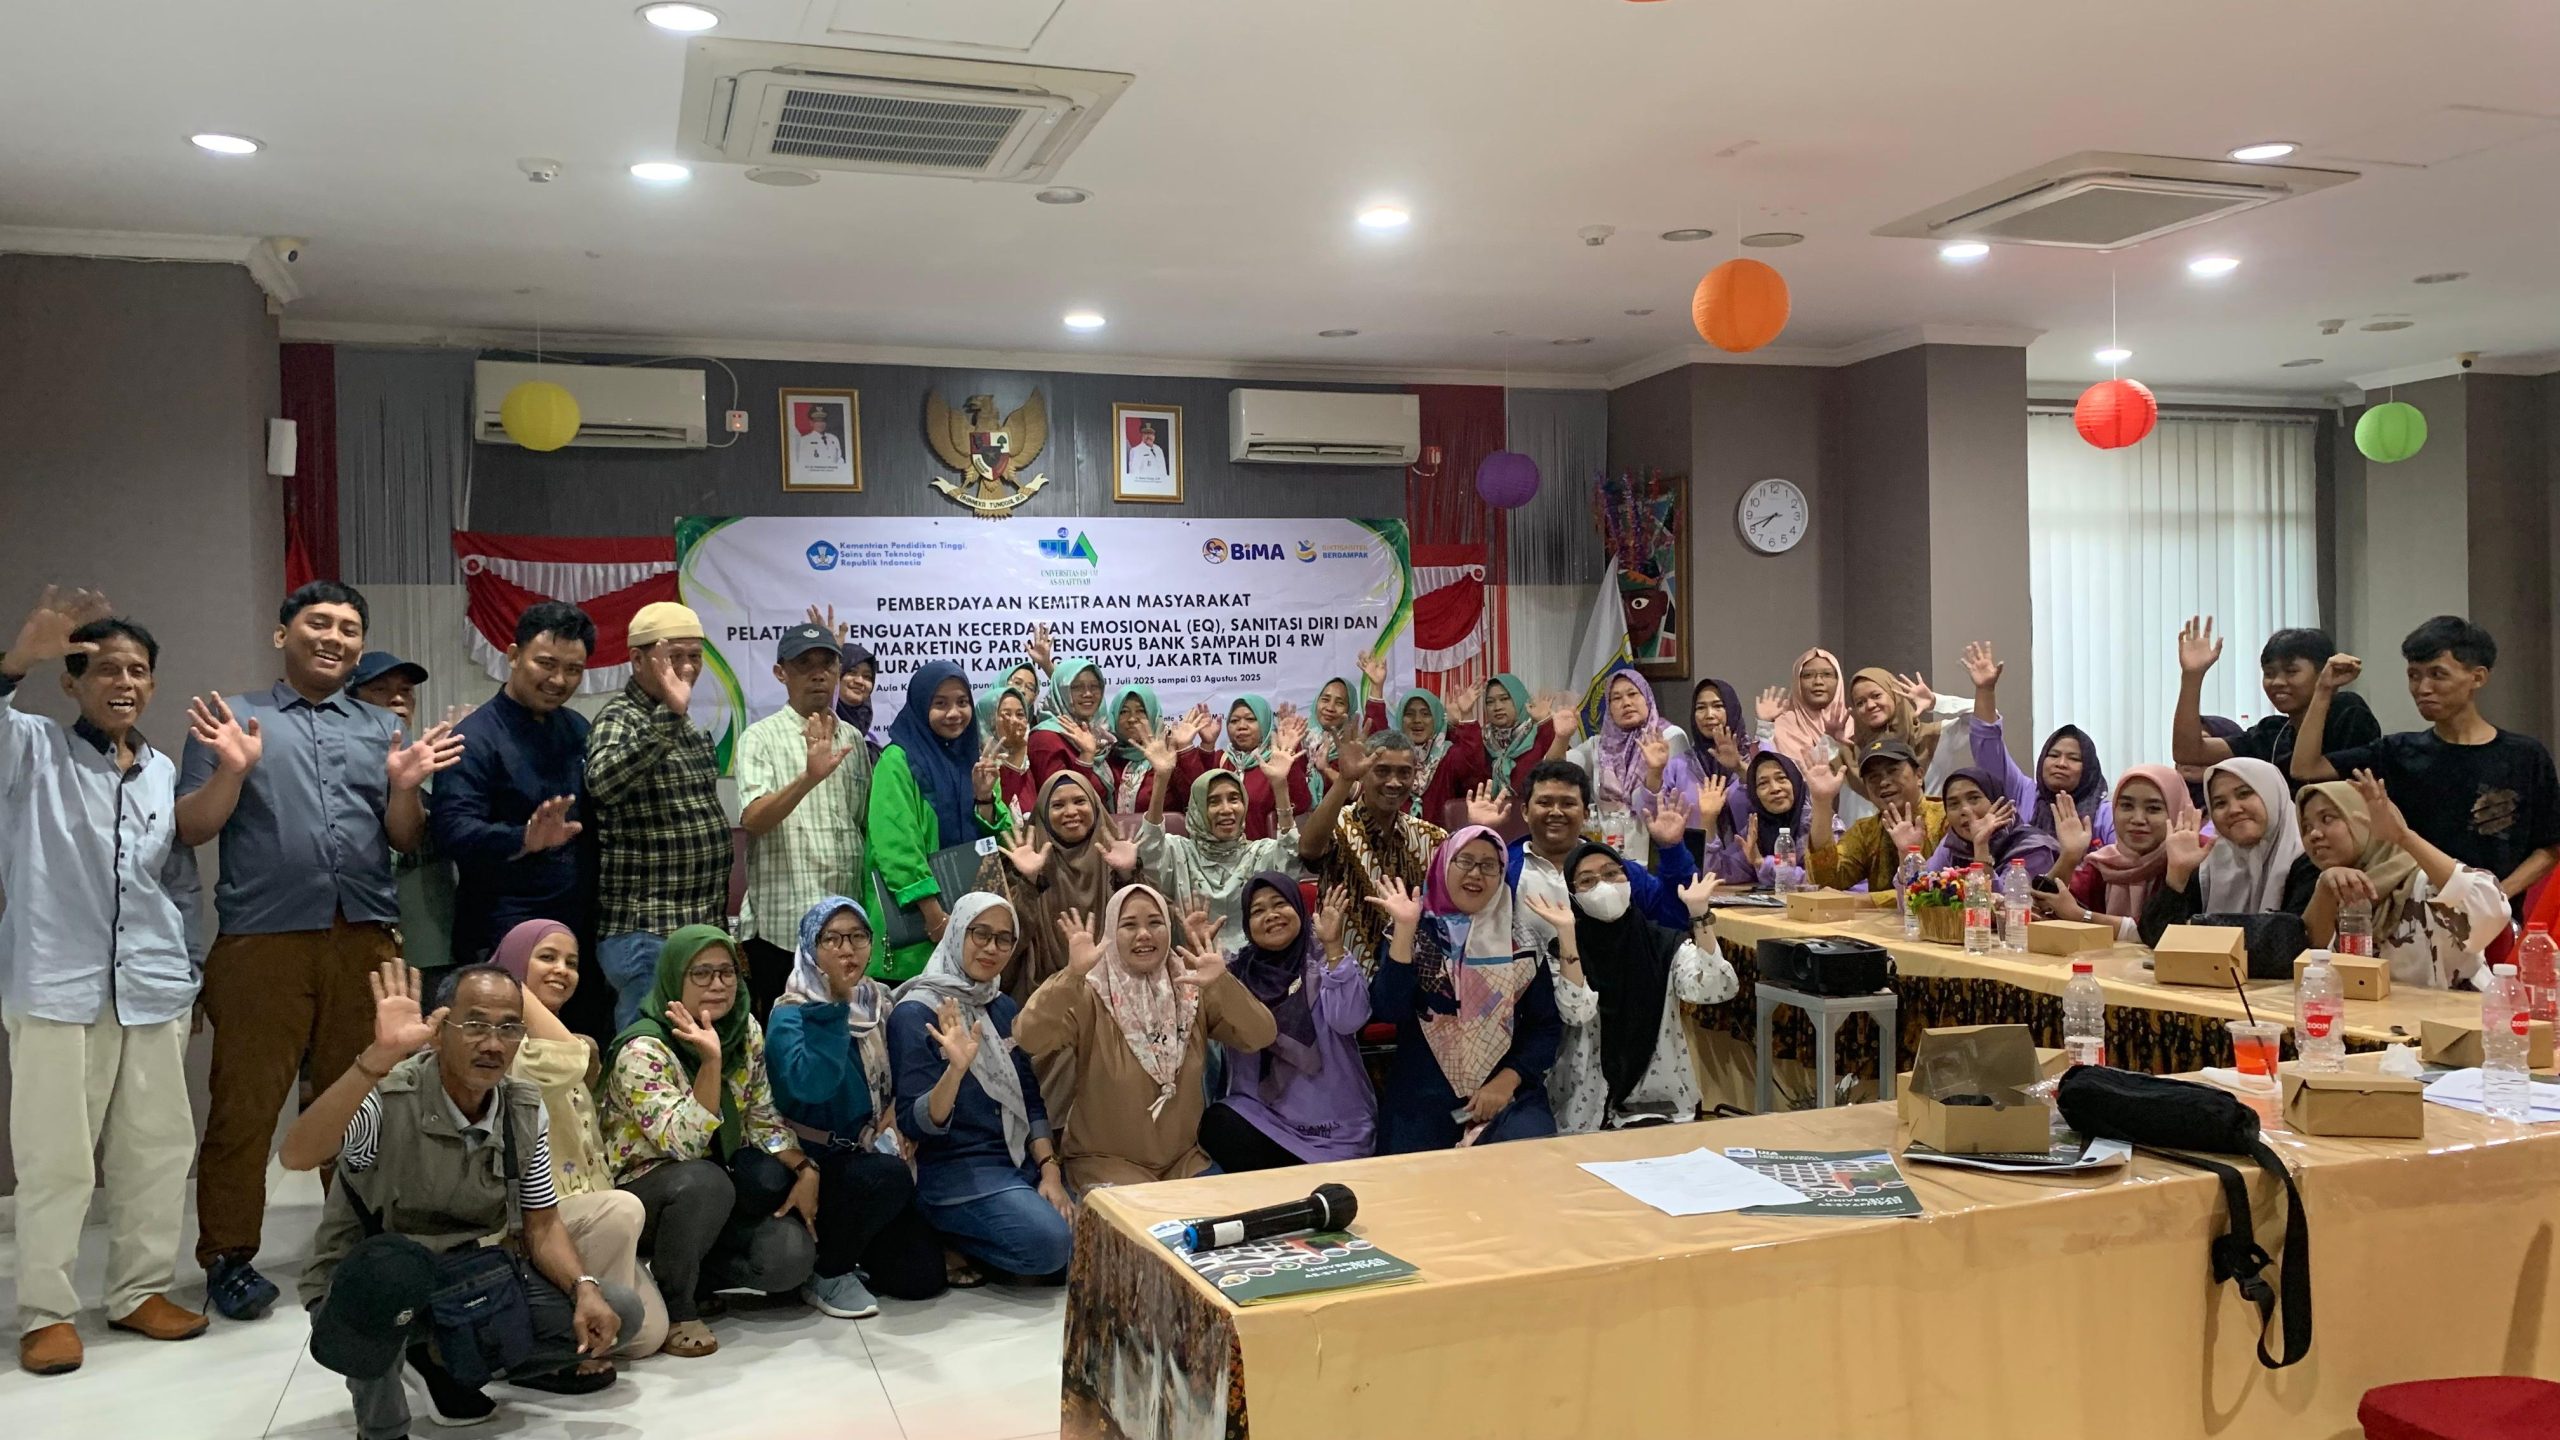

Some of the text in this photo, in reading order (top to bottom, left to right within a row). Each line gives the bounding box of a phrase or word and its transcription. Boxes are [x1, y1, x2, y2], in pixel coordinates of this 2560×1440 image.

[1760, 488, 1766, 497] 11
[1770, 484, 1779, 494] 12
[1750, 498, 1760, 507] 10
[1791, 499, 1798, 509] 2
[1746, 510, 1753, 520] 9
[1793, 511, 1800, 521] 3
[1789, 526, 1796, 535] 4
[1758, 534, 1764, 543] 7
[1768, 538, 1776, 547] 6
[1780, 534, 1787, 544] 5
[840, 542, 888, 550] Kementrian
[866, 550, 882, 558] dan
[884, 550, 925, 559] Teknologi
[841, 559, 878, 567] Republik
[877, 594, 1251, 611] PEMBERDAYAAN KEMITRAAN MASYARAKAT
[842, 623, 951, 638] ENGUATAN
[1081, 620, 1181, 634] EMOSIONAL
[1187, 618, 1225, 634] (EQ),
[1231, 617, 1302, 631] SANITASI
[1308, 617, 1338, 630] DIRI
[1344, 616, 1378, 629] DAN
[874, 639, 982, 656] MARKETING
[1053, 637, 1133, 652] ENGURUS
[1139, 636, 1185, 650] BANK
[1191, 635, 1259, 649] SAMPAH
[1265, 634, 1280, 647] DI
[1286, 634, 1295, 647] 4
[1301, 633, 1325, 646] RW
[1147, 653, 1223, 667] JAKARTA
[1228, 651, 1278, 665] TIMUR
[1116, 677, 1130, 685] Juli
[1134, 676, 1155, 684] 2025
[1157, 676, 1188, 686] sampai
[1191, 675, 1201, 683] 03
[1205, 675, 1238, 684] Agustus
[876, 684, 898, 692] Aula
